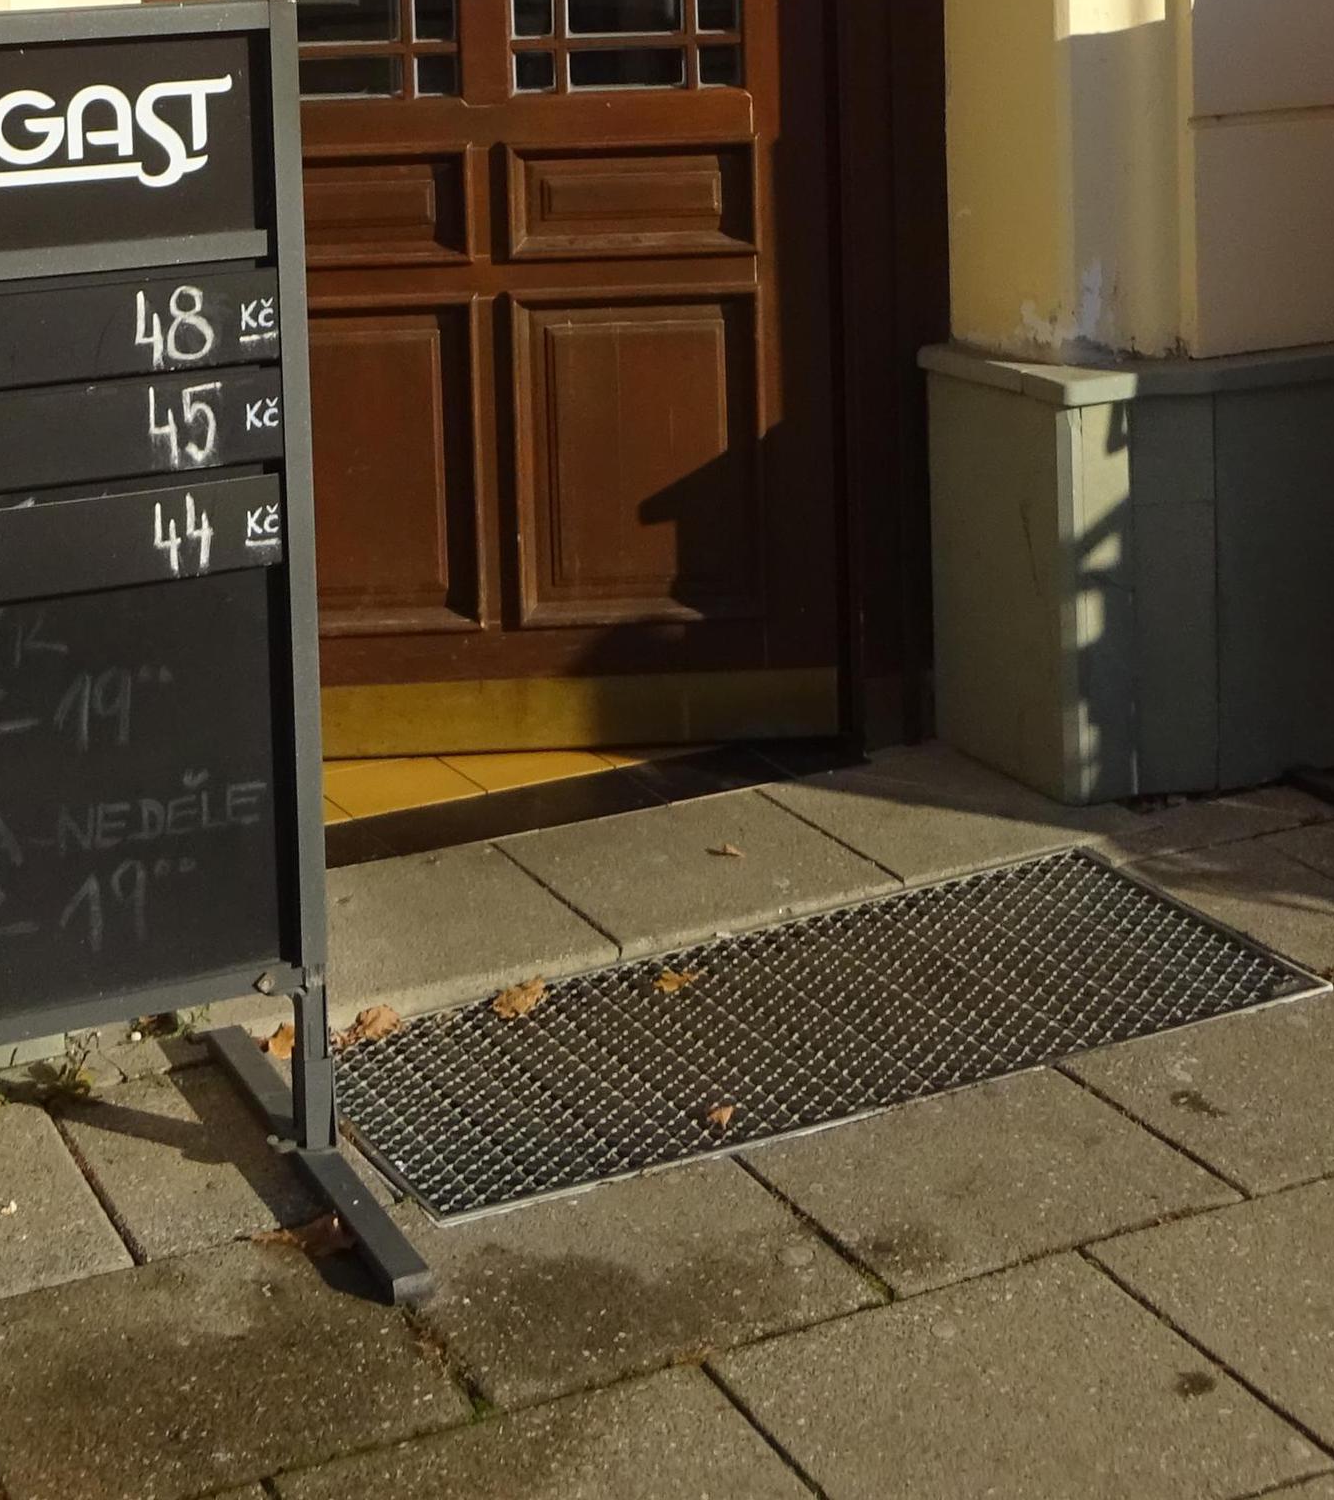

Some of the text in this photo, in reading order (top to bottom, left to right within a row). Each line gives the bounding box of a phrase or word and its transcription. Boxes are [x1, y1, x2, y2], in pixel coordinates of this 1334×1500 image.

[135, 285, 275, 370] 48 Kč
[148, 381, 280, 469] 45 Kč
[153, 491, 280, 577] 44 Kč
